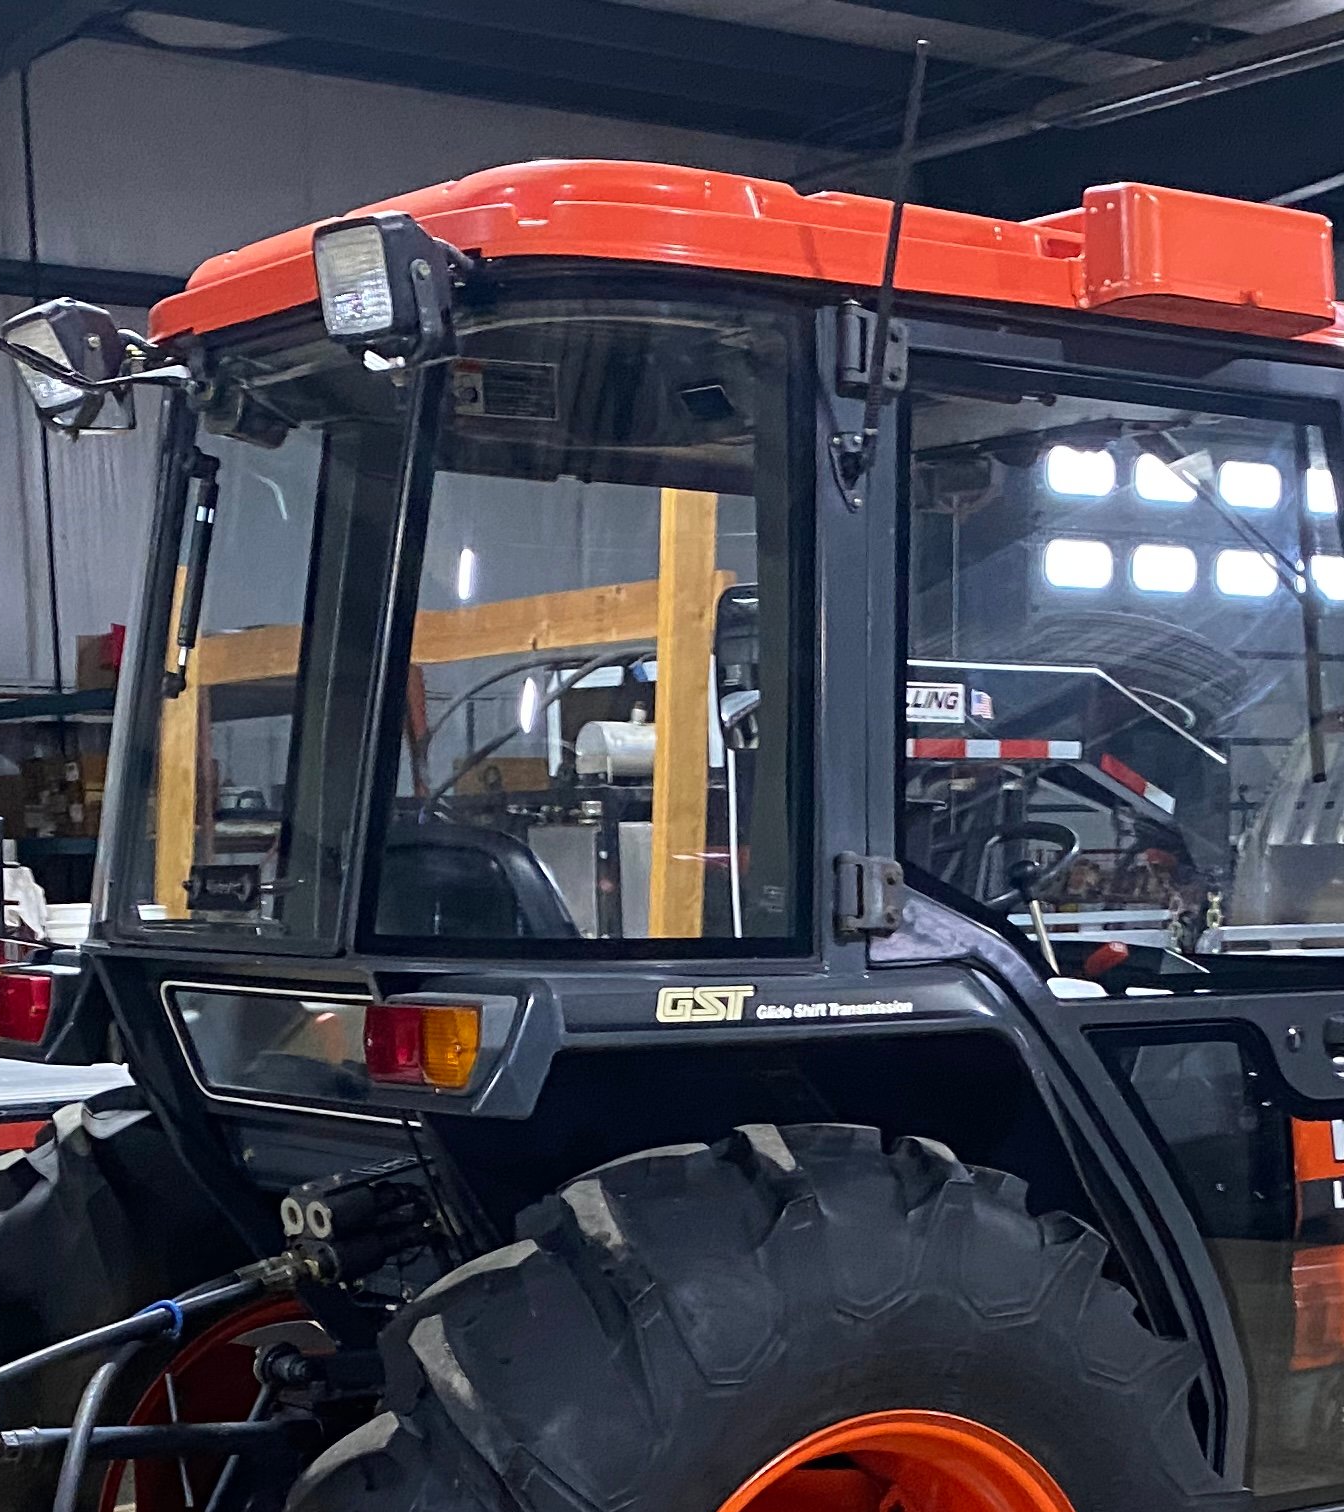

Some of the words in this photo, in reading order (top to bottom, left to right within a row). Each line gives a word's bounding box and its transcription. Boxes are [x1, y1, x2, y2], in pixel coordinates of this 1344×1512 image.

[906, 690, 959, 709] LING
[656, 985, 755, 1023] GST
[756, 1004, 792, 1019] Glide
[793, 1002, 828, 1018] Shift
[829, 1000, 913, 1016] Transmission
